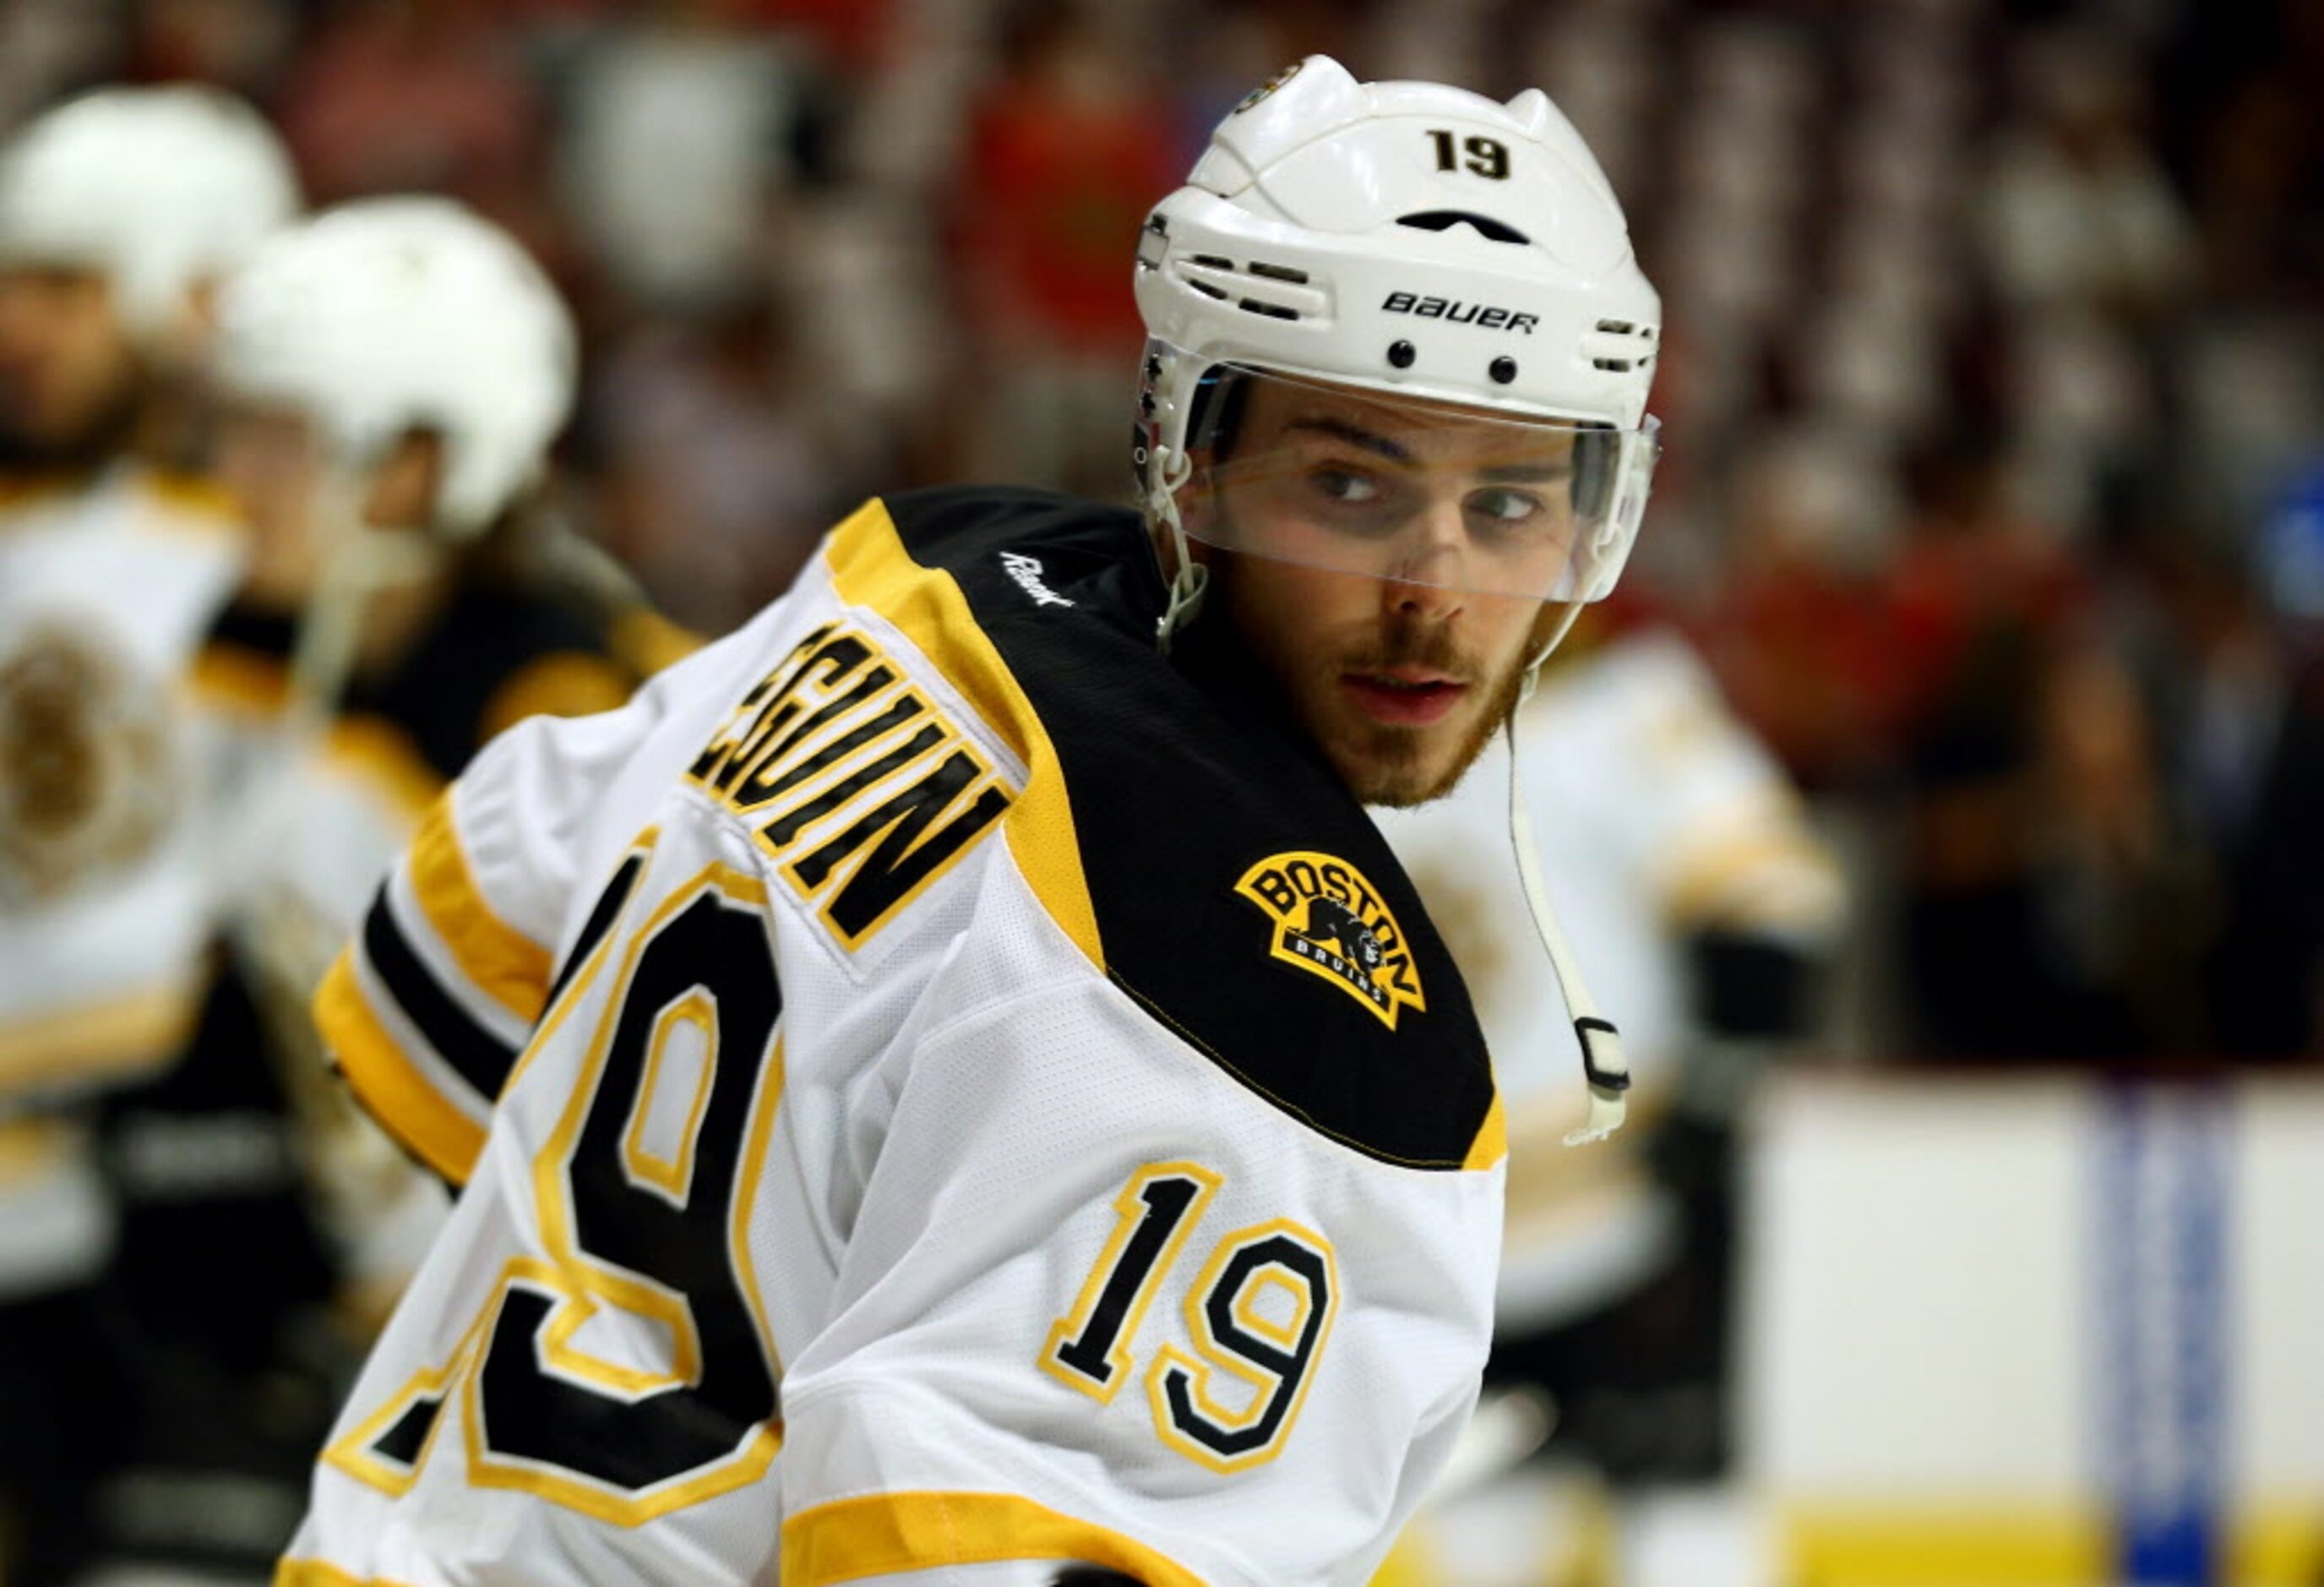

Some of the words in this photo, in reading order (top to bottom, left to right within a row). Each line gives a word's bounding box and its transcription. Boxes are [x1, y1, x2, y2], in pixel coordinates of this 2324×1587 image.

[1426, 128, 1511, 181] 19
[1249, 859, 1418, 995] BOSTON
[1295, 939, 1382, 1002] BRUINS
[1036, 1159, 1341, 1475] 19
